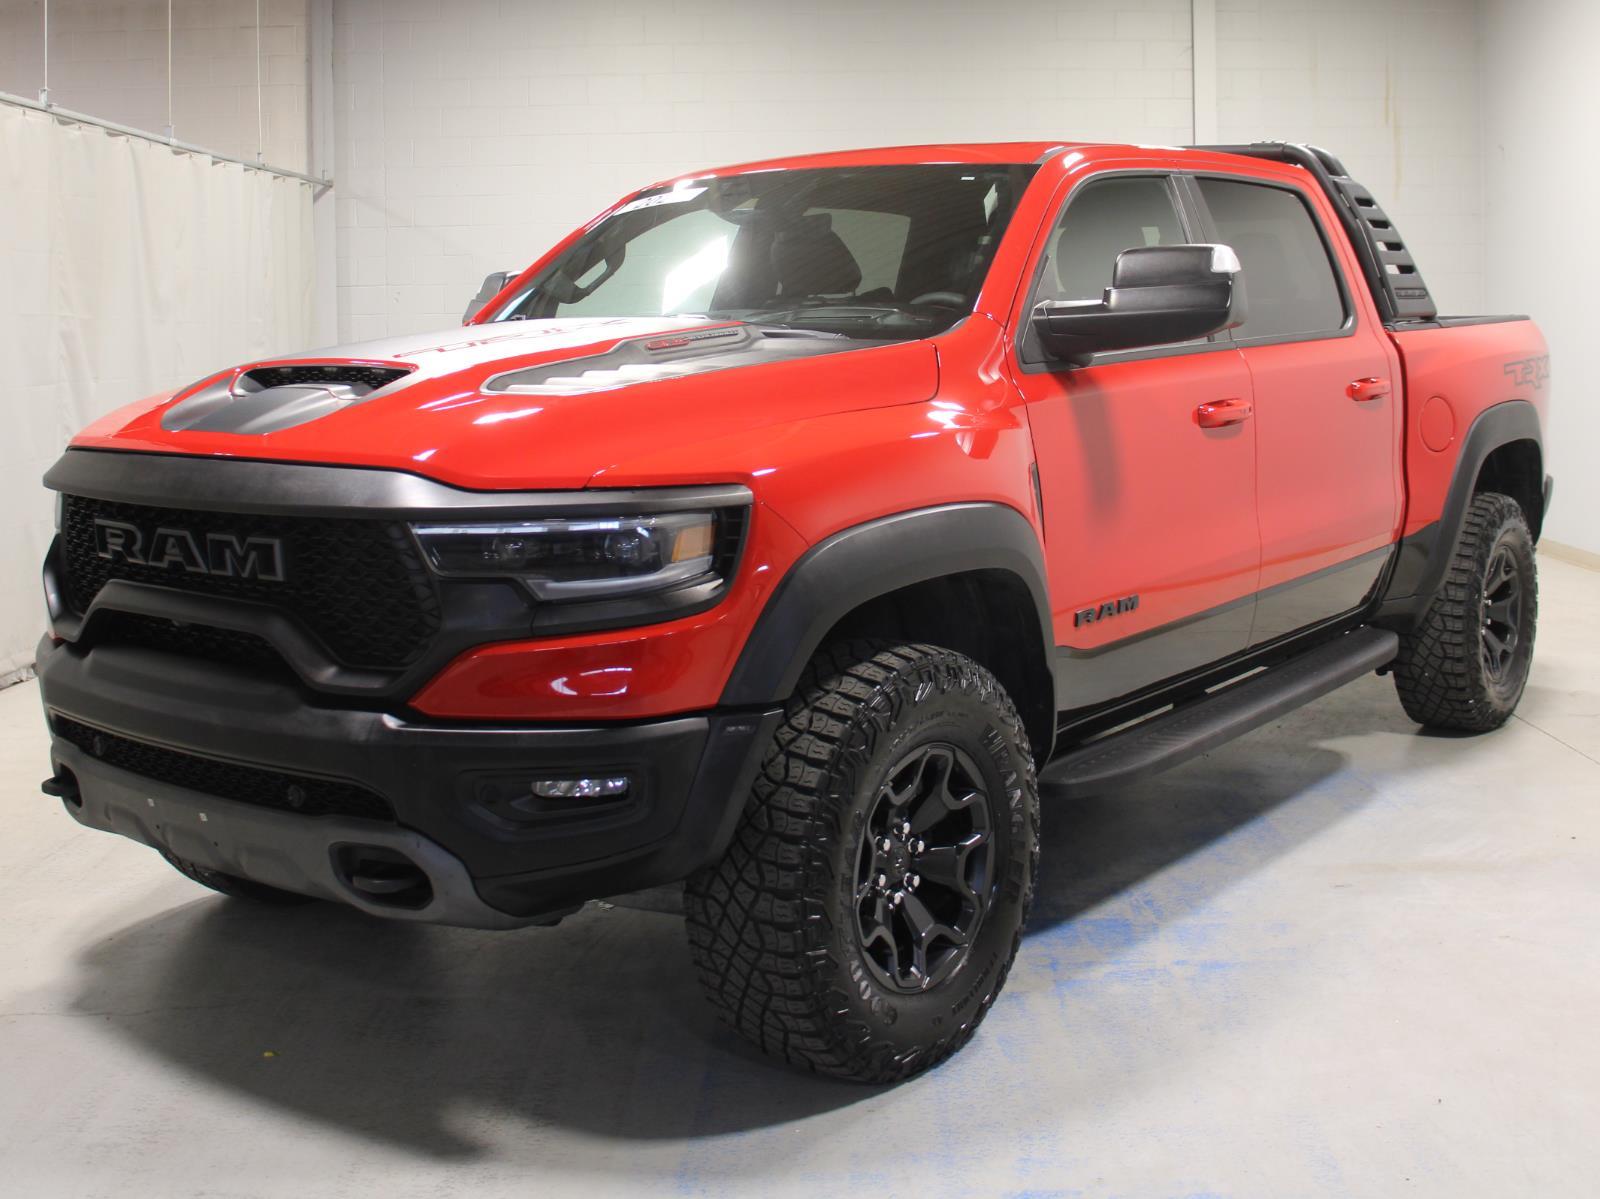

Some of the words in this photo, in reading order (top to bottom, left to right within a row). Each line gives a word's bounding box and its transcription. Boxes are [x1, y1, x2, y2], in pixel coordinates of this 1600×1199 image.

[94, 518, 284, 581] RAM
[1073, 593, 1139, 628] RAM
[980, 723, 1026, 904] WRANGLER
